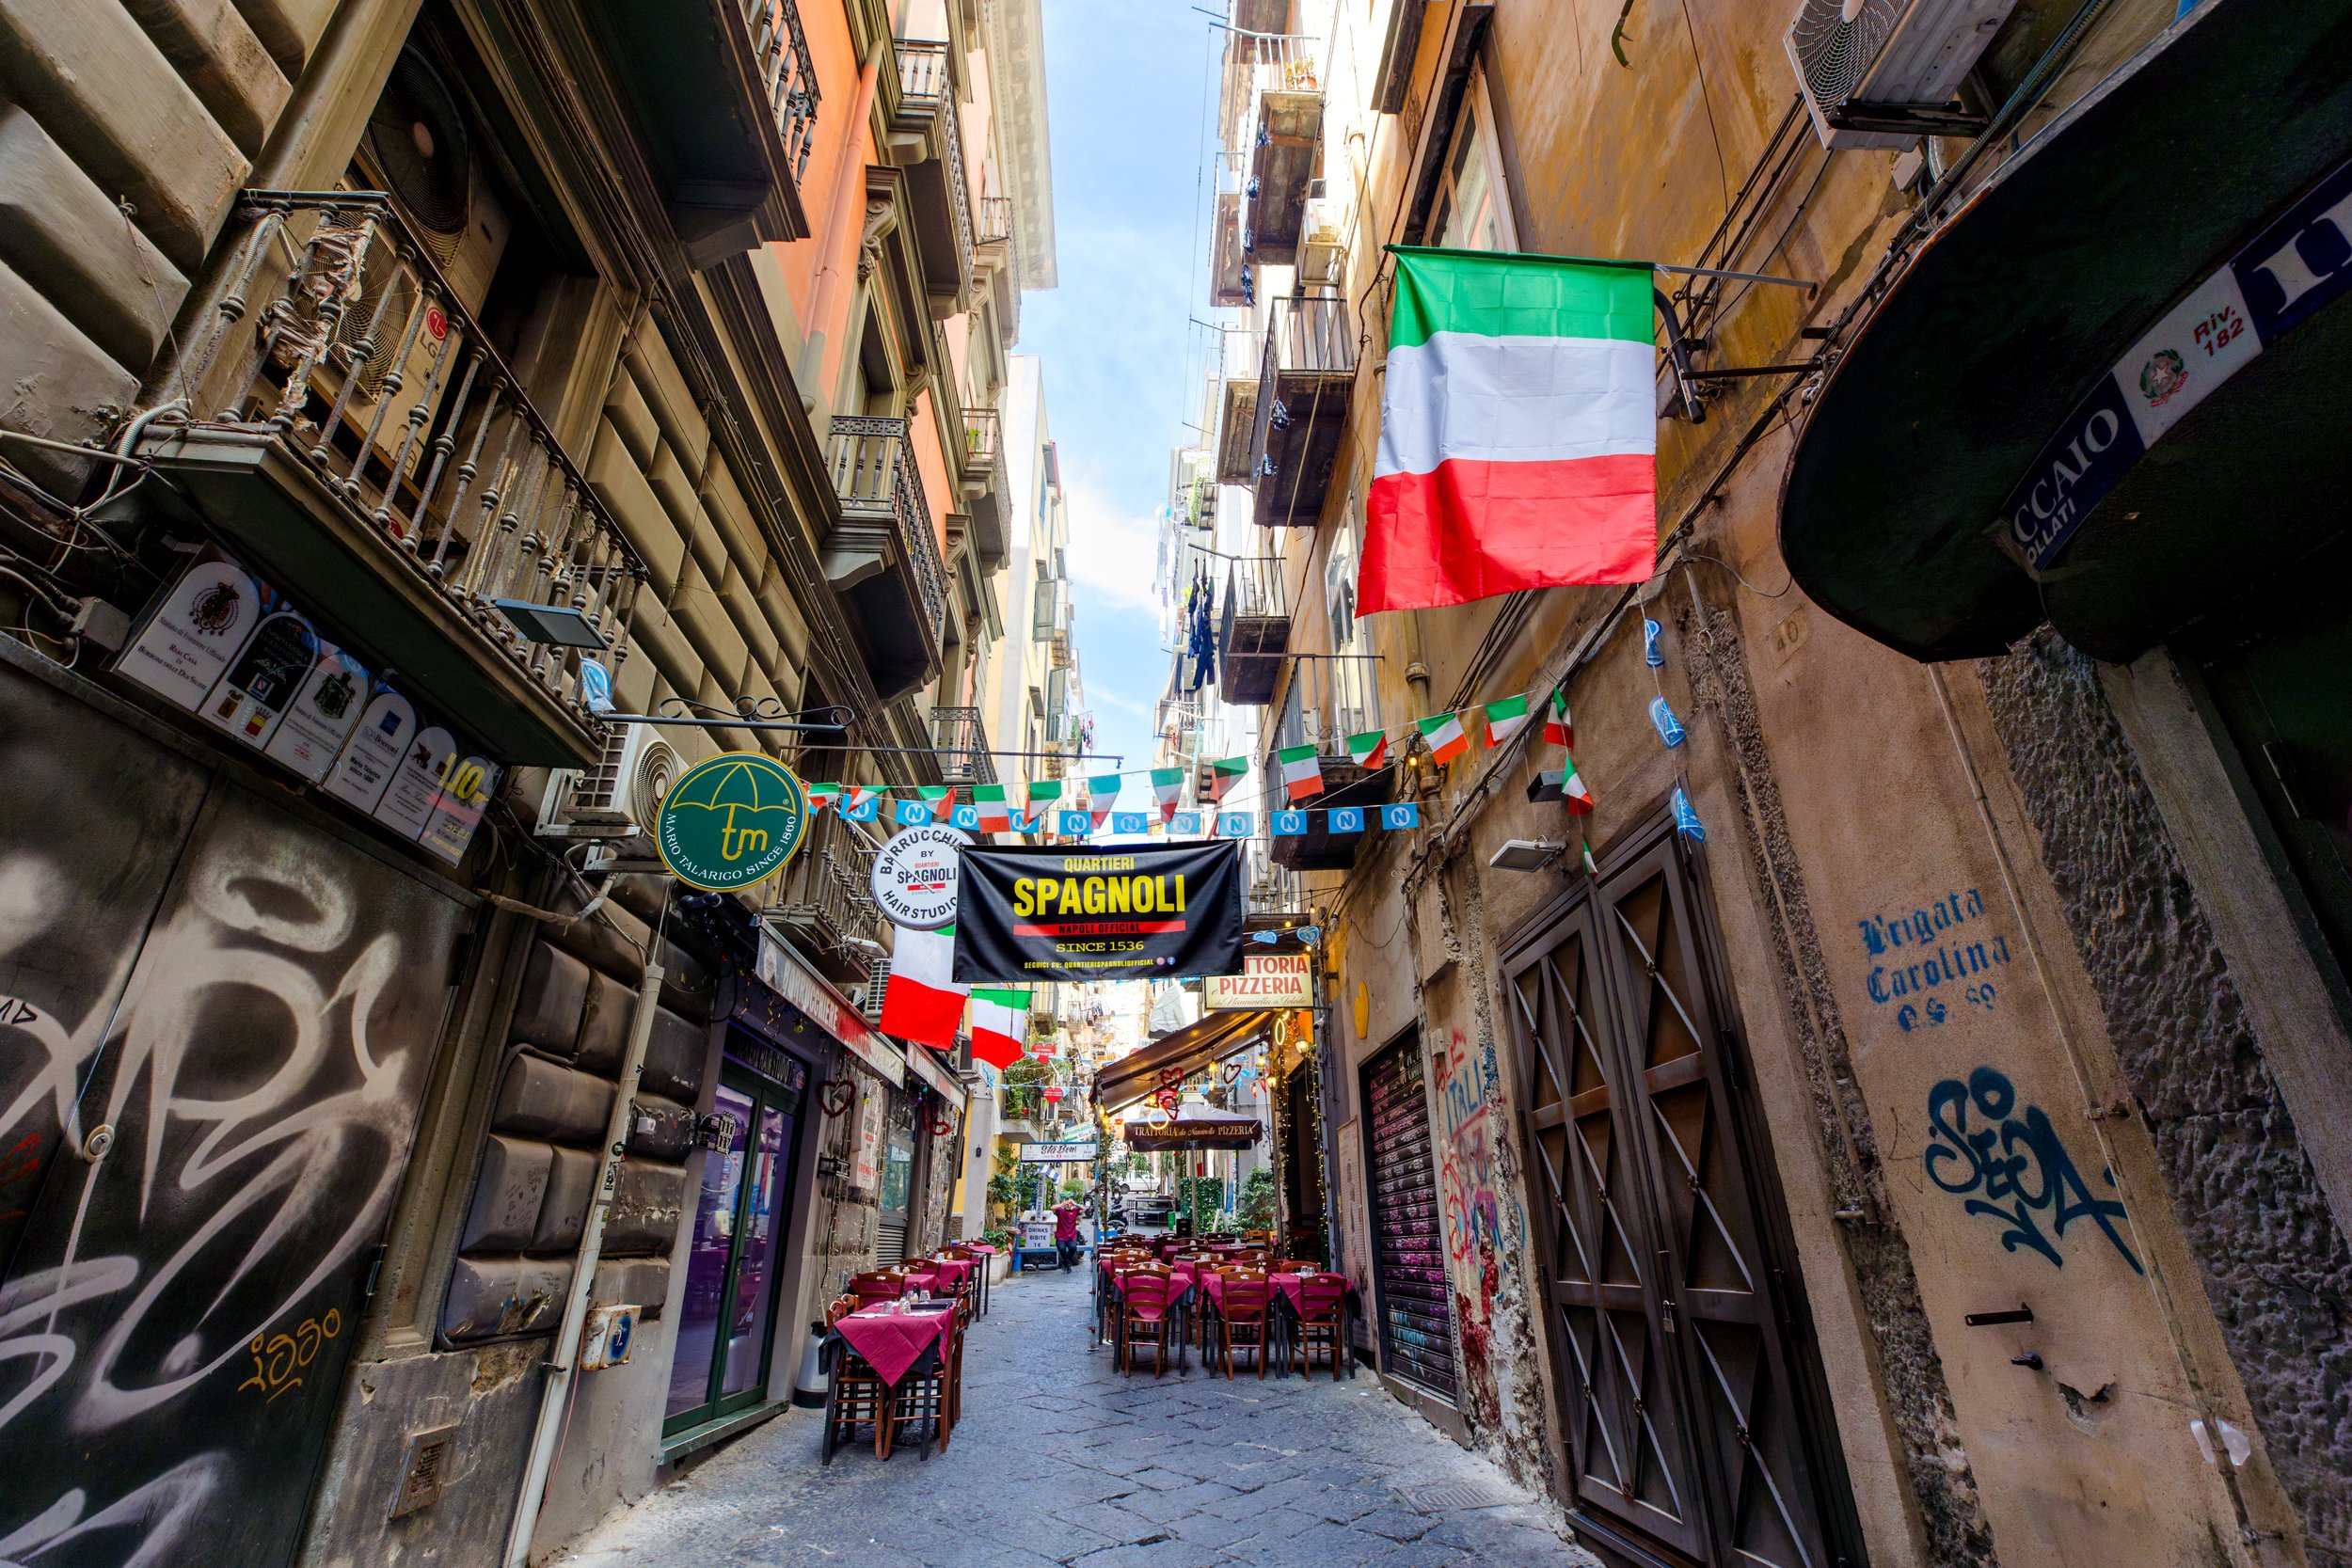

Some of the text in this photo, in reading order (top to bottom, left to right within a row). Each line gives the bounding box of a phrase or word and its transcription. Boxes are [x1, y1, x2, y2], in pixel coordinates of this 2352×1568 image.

[2193, 306, 2236, 344] Riv.
[420, 331, 438, 359] LG
[2203, 318, 2244, 357] 182
[2013, 408, 2120, 543] CCAIO
[666, 814, 797, 881] MARIO TALARICO SINCE 1860
[920, 849, 934, 858] BY
[1064, 856, 1135, 873] QUARTIERI
[897, 867, 957, 884] SPAGNOLI
[1013, 874, 1185, 917] SPAGNOLI
[1058, 922, 1141, 934] NAPOLI OFFICIAL
[1859, 888, 1985, 957] Brigata
[1056, 941, 1144, 953] SINCE 1536
[1024, 961, 1049, 970] SEGUICI
[1064, 958, 1154, 970] QUARTIERISPAGNOLIOFFICIAL
[1867, 935, 2010, 1004] Carolina
[1219, 977, 1303, 995] PIZZERIA
[1280, 996, 1307, 1006] Toledo
[1135, 1126, 1179, 1136] TRATTORIA
[1218, 1126, 1254, 1135] PIZZERIA
